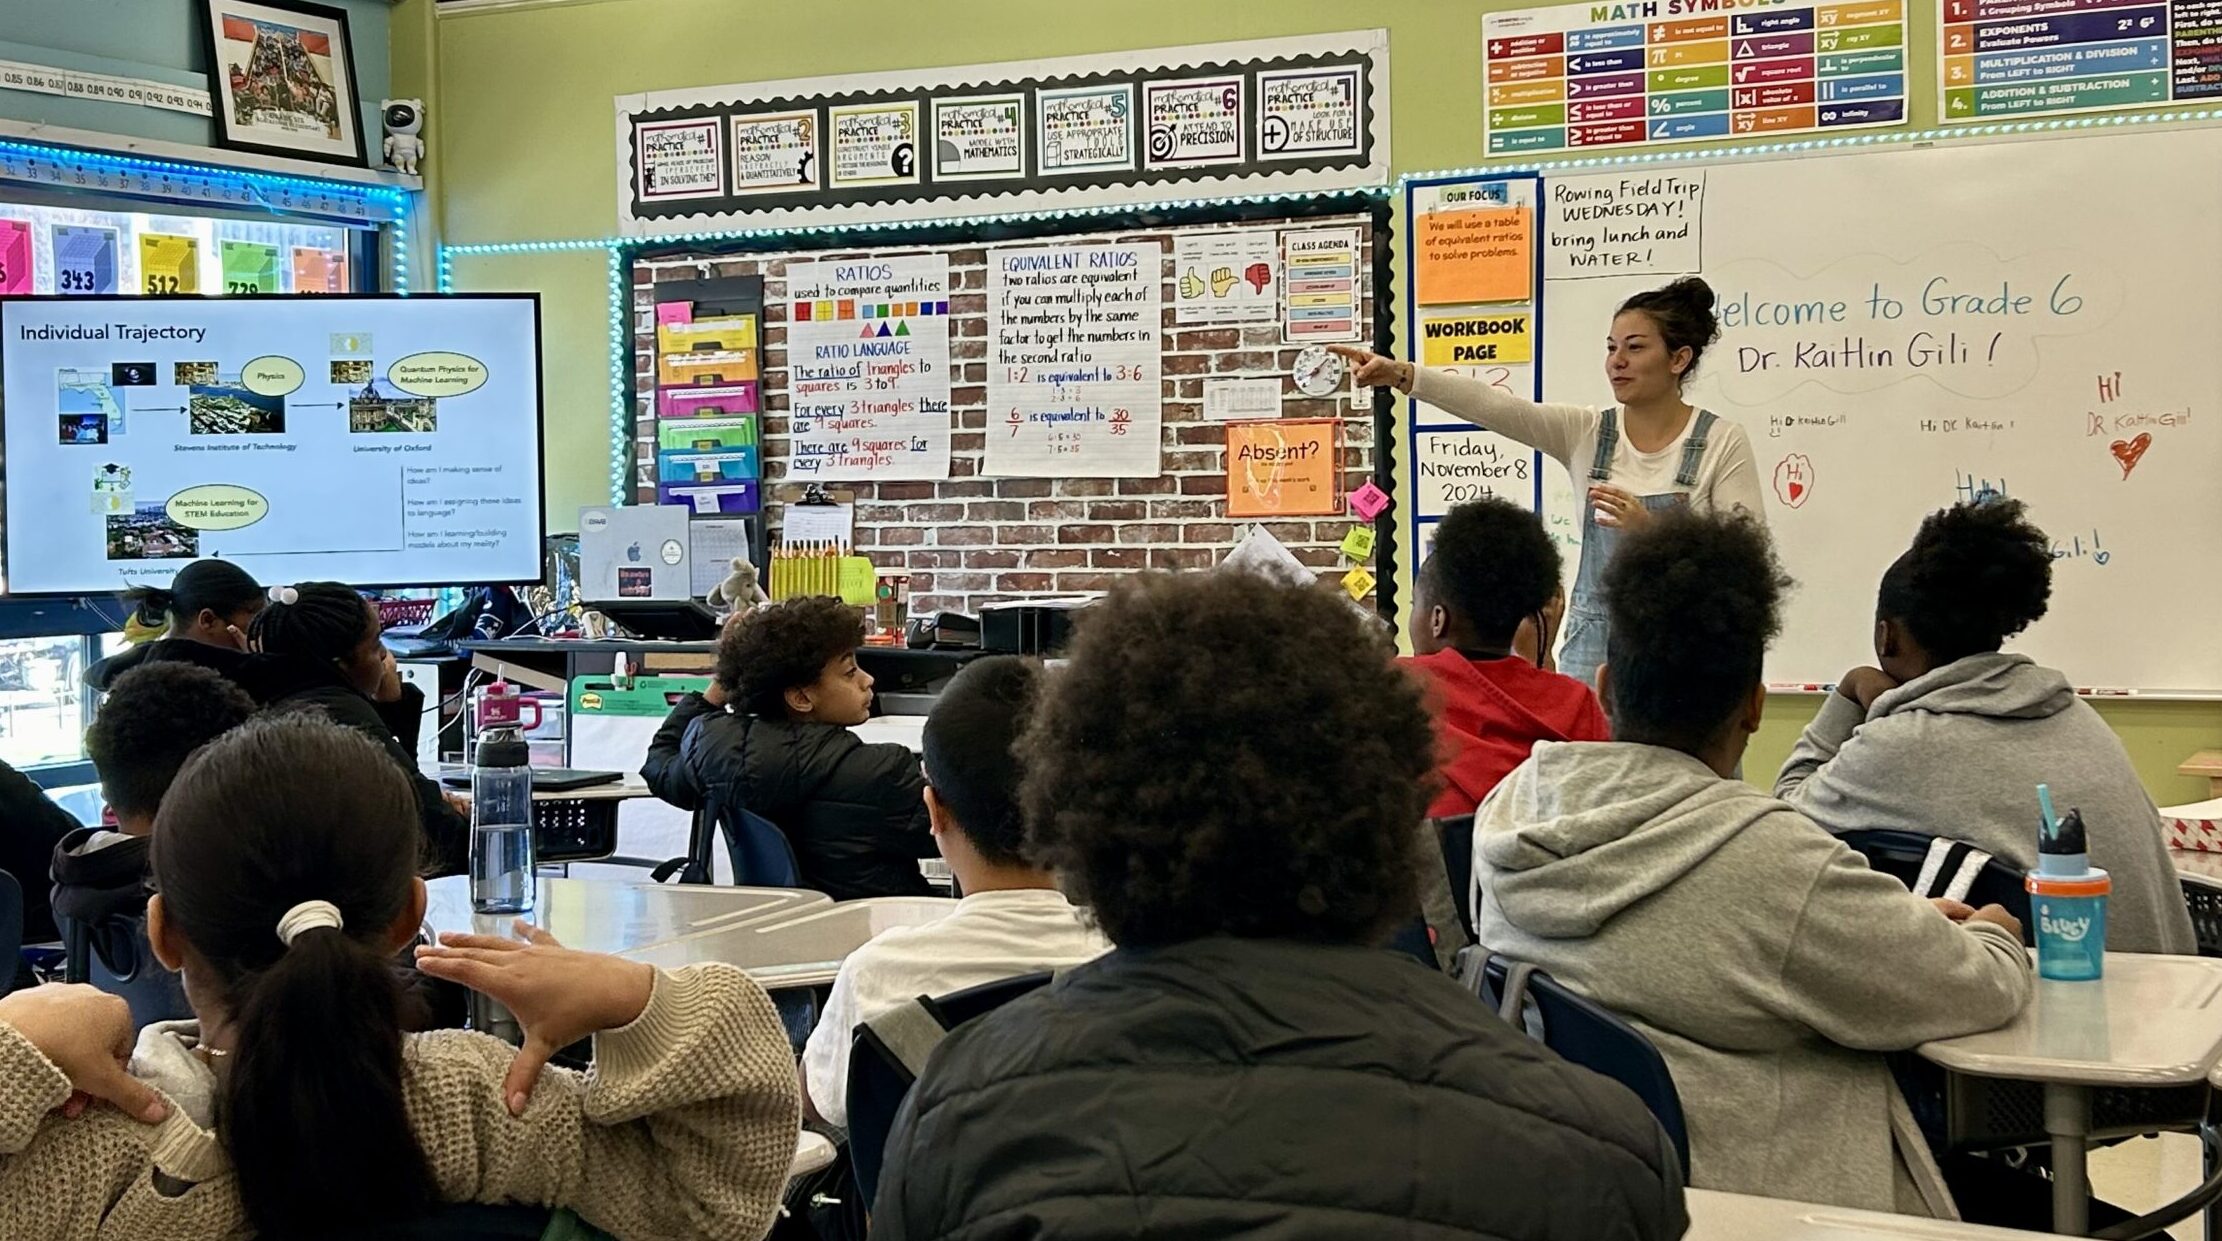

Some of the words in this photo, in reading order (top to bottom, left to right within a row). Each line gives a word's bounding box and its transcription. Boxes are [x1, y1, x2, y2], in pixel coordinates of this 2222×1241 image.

[1591, 1, 1657, 23] MATH
[1979, 22, 2049, 37] EXPONENTS
[1761, 42, 1789, 50] triangle
[1950, 34, 1967, 48] 2.
[1979, 38, 2021, 48] Evaluate
[2023, 34, 2059, 44] Powers
[1980, 53, 2072, 69] MULTIPLICATION
[2075, 50, 2083, 59] &
[2085, 47, 2138, 59] DIVISION
[1950, 67, 1967, 80] 3.
[1981, 87, 2036, 100] ADDITION
[2039, 85, 2046, 94] &
[2049, 79, 2130, 94] SUBTRACTION
[1153, 103, 1199, 114] PRACTICE
[1951, 97, 1967, 110] 4.
[1183, 121, 1218, 132] ATTEND
[1220, 120, 1232, 131] TO
[1180, 131, 1235, 146] PRECISION
[1293, 131, 1303, 143] OF
[1305, 128, 1352, 142] STRUCTURE
[740, 153, 771, 163] REASON
[964, 146, 1017, 160] MATHEMATICS
[1064, 146, 1124, 160] STRATEGICALLY
[27, 167, 37, 179] 33
[75, 173, 86, 185] 35
[745, 168, 796, 180] QUANTITATIVELY
[1446, 191, 1467, 203] OUR
[1469, 189, 1501, 201] FOCUS
[1555, 183, 1614, 206] Rowing
[1619, 179, 1662, 198] Field
[1666, 177, 1700, 199] Trip
[1562, 201, 1685, 222] WEDNESDAY!
[1429, 221, 1445, 231] We
[1446, 220, 1463, 230] will
[1464, 220, 1483, 230] use
[1484, 219, 1491, 228] a
[1493, 217, 1521, 228] table
[1292, 241, 1316, 251] CLASS
[1318, 240, 1349, 250] AGENDA
[1425, 236, 1436, 247] of
[1438, 234, 1491, 248] equivalent
[1493, 231, 1523, 243] ratios
[1552, 232, 1595, 251] bring
[1602, 226, 1650, 245] lunch
[1655, 223, 1688, 241] and
[1002, 253, 1080, 273] EQUIVALENT
[1089, 251, 1138, 268] RATIOS
[1429, 252, 1440, 261] to
[1442, 250, 1468, 260] solve
[1570, 249, 1653, 267] WATER!
[61, 269, 94, 290] 343
[836, 264, 893, 282] RATIOS
[1002, 274, 1023, 287] two
[1026, 271, 1057, 286] ratios
[1060, 271, 1078, 284] are
[1081, 267, 1138, 287] equivalent
[147, 274, 179, 294] 512
[795, 284, 820, 299] used
[825, 285, 836, 296] to
[837, 283, 882, 297] compare
[884, 278, 941, 299] quantities
[1001, 290, 1012, 306] if
[1014, 293, 1032, 309] you
[1034, 293, 1053, 305] can
[1055, 288, 1103, 311] multiply
[1104, 287, 1133, 303] each
[1135, 286, 1148, 301] of
[1715, 291, 1846, 329] elcome
[1865, 282, 1903, 320] to
[1922, 276, 2032, 316] Grade
[2050, 273, 2083, 316] 6
[1001, 309, 1018, 325] the
[1021, 307, 1065, 325] numbers
[1068, 308, 1083, 328] by
[1086, 308, 1103, 322] the
[1106, 310, 1139, 322] same
[21, 323, 109, 341] Individual
[115, 324, 206, 343] Trajectory
[1425, 318, 1525, 338] WORKBOOK
[999, 328, 1029, 346] factor
[1034, 330, 1045, 344] to
[1046, 329, 1064, 349] get
[1067, 326, 1085, 343] the
[1087, 325, 1136, 343] numbers
[1138, 328, 1150, 342] in
[816, 343, 850, 359] RATIO
[853, 340, 912, 358] LANGUAGE
[1453, 344, 1498, 361] PAGE
[1739, 345, 1781, 374] Dr.
[1795, 336, 1892, 370] Kaitlin
[1908, 331, 1968, 368] Gili
[257, 372, 285, 382] Physics
[400, 365, 436, 374] Quantum
[438, 364, 466, 374] Physics
[467, 365, 480, 373] for
[793, 364, 815, 379] The
[818, 363, 846, 378] ratio
[848, 360, 863, 377] of
[867, 359, 915, 380] triangles
[919, 358, 931, 374] to
[400, 376, 433, 384] Machine
[435, 376, 468, 385] Learning
[795, 380, 841, 397] squares
[846, 378, 857, 391] is
[864, 377, 873, 390] 3
[876, 376, 887, 390] to
[794, 403, 813, 418] For
[815, 403, 846, 421] every
[850, 400, 860, 414] 3
[861, 398, 915, 417] triangles
[919, 397, 948, 413] there
[793, 420, 811, 433] are
[814, 416, 824, 429] 9
[1920, 419, 1937, 432] Hi
[174, 444, 205, 452] Stevens
[207, 443, 240, 452] Institute
[242, 443, 251, 452] of
[253, 443, 297, 453] Technology
[353, 444, 392, 453] University
[393, 444, 402, 452] of
[404, 444, 432, 452] Oxford
[1238, 440, 1320, 461] Absent?
[1429, 436, 1505, 462] Friday,
[1420, 458, 1510, 479] November
[1515, 458, 1529, 479] 8
[1442, 483, 1494, 502] 2024
[175, 500, 207, 508] Machine
[210, 499, 245, 508] Learning
[247, 498, 259, 507] for
[184, 510, 208, 518] STEM
[210, 509, 249, 518] Education
[118, 567, 137, 576] Tufts
[140, 567, 178, 577] University
